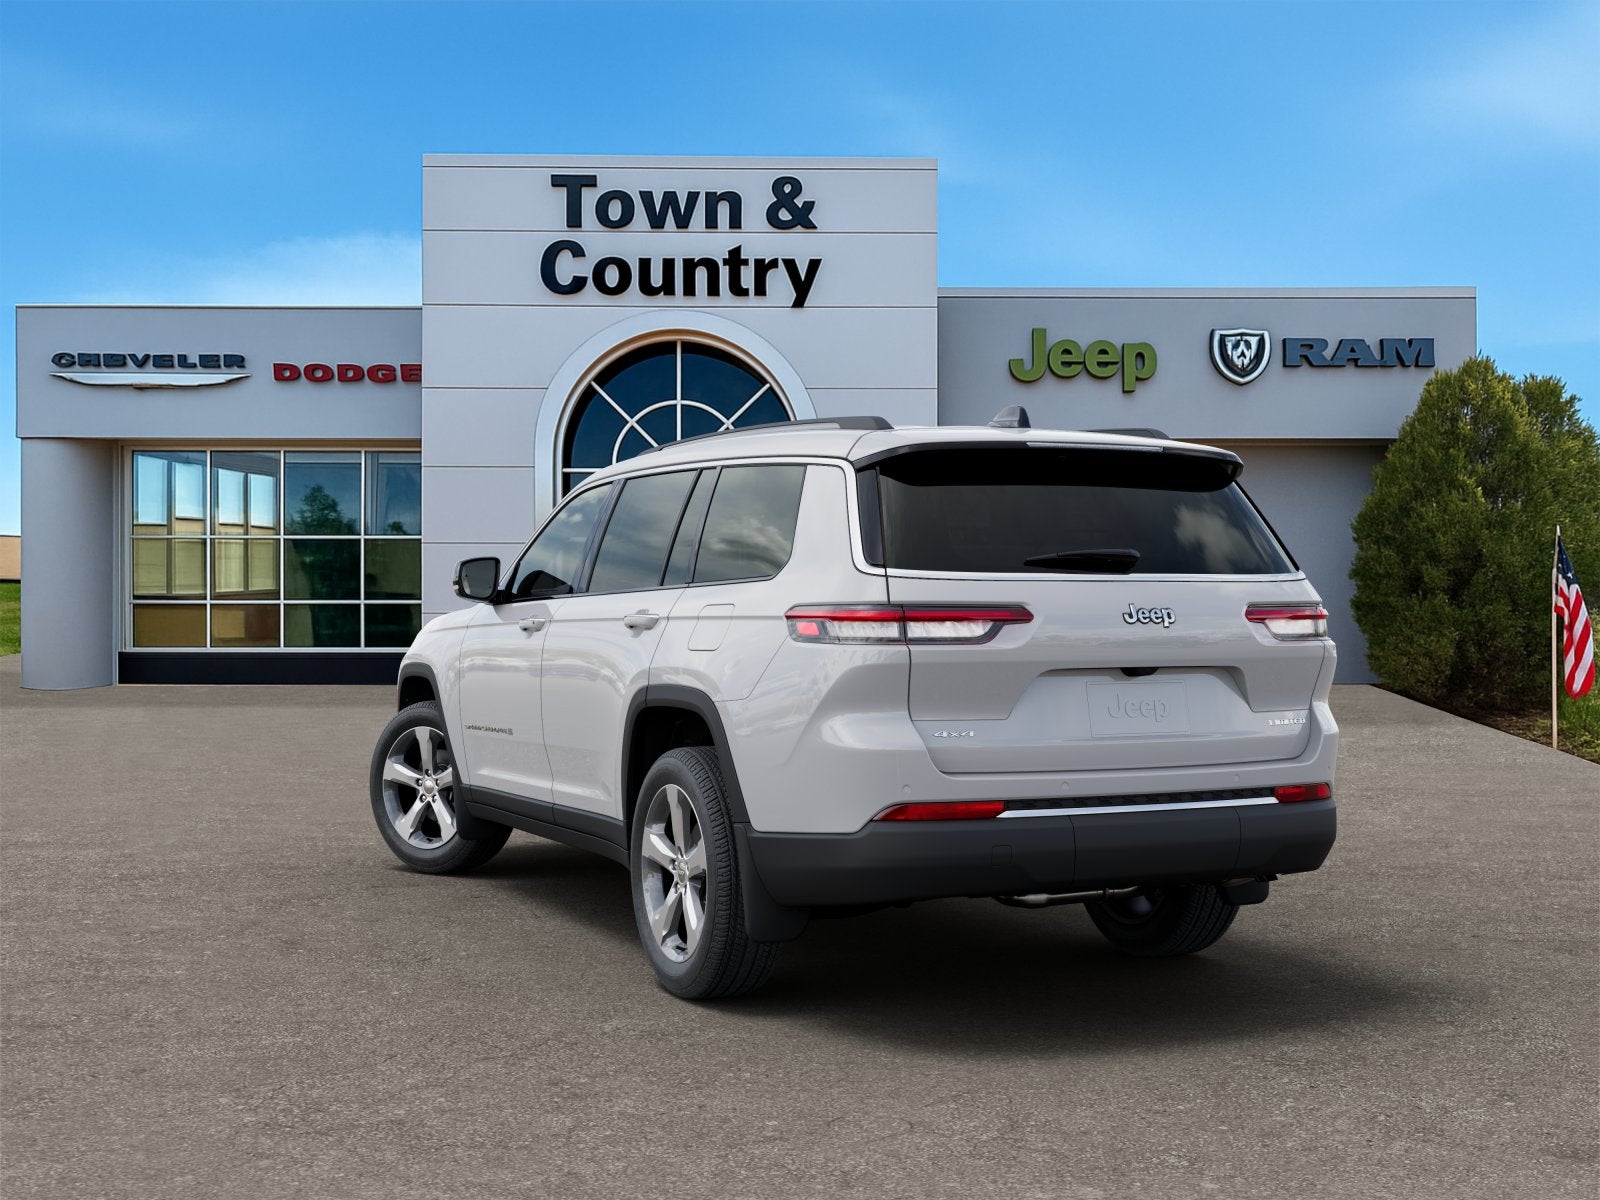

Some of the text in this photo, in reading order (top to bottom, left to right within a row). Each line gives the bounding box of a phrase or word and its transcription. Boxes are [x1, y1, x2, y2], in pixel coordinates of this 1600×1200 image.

[550, 174, 818, 230] Town &
[540, 239, 822, 308] Country
[1009, 328, 1157, 392] Jeep
[1282, 337, 1435, 367] RAM
[273, 362, 422, 384] DODGE
[1122, 602, 1177, 629] Jeep
[1106, 692, 1169, 723] Jeep
